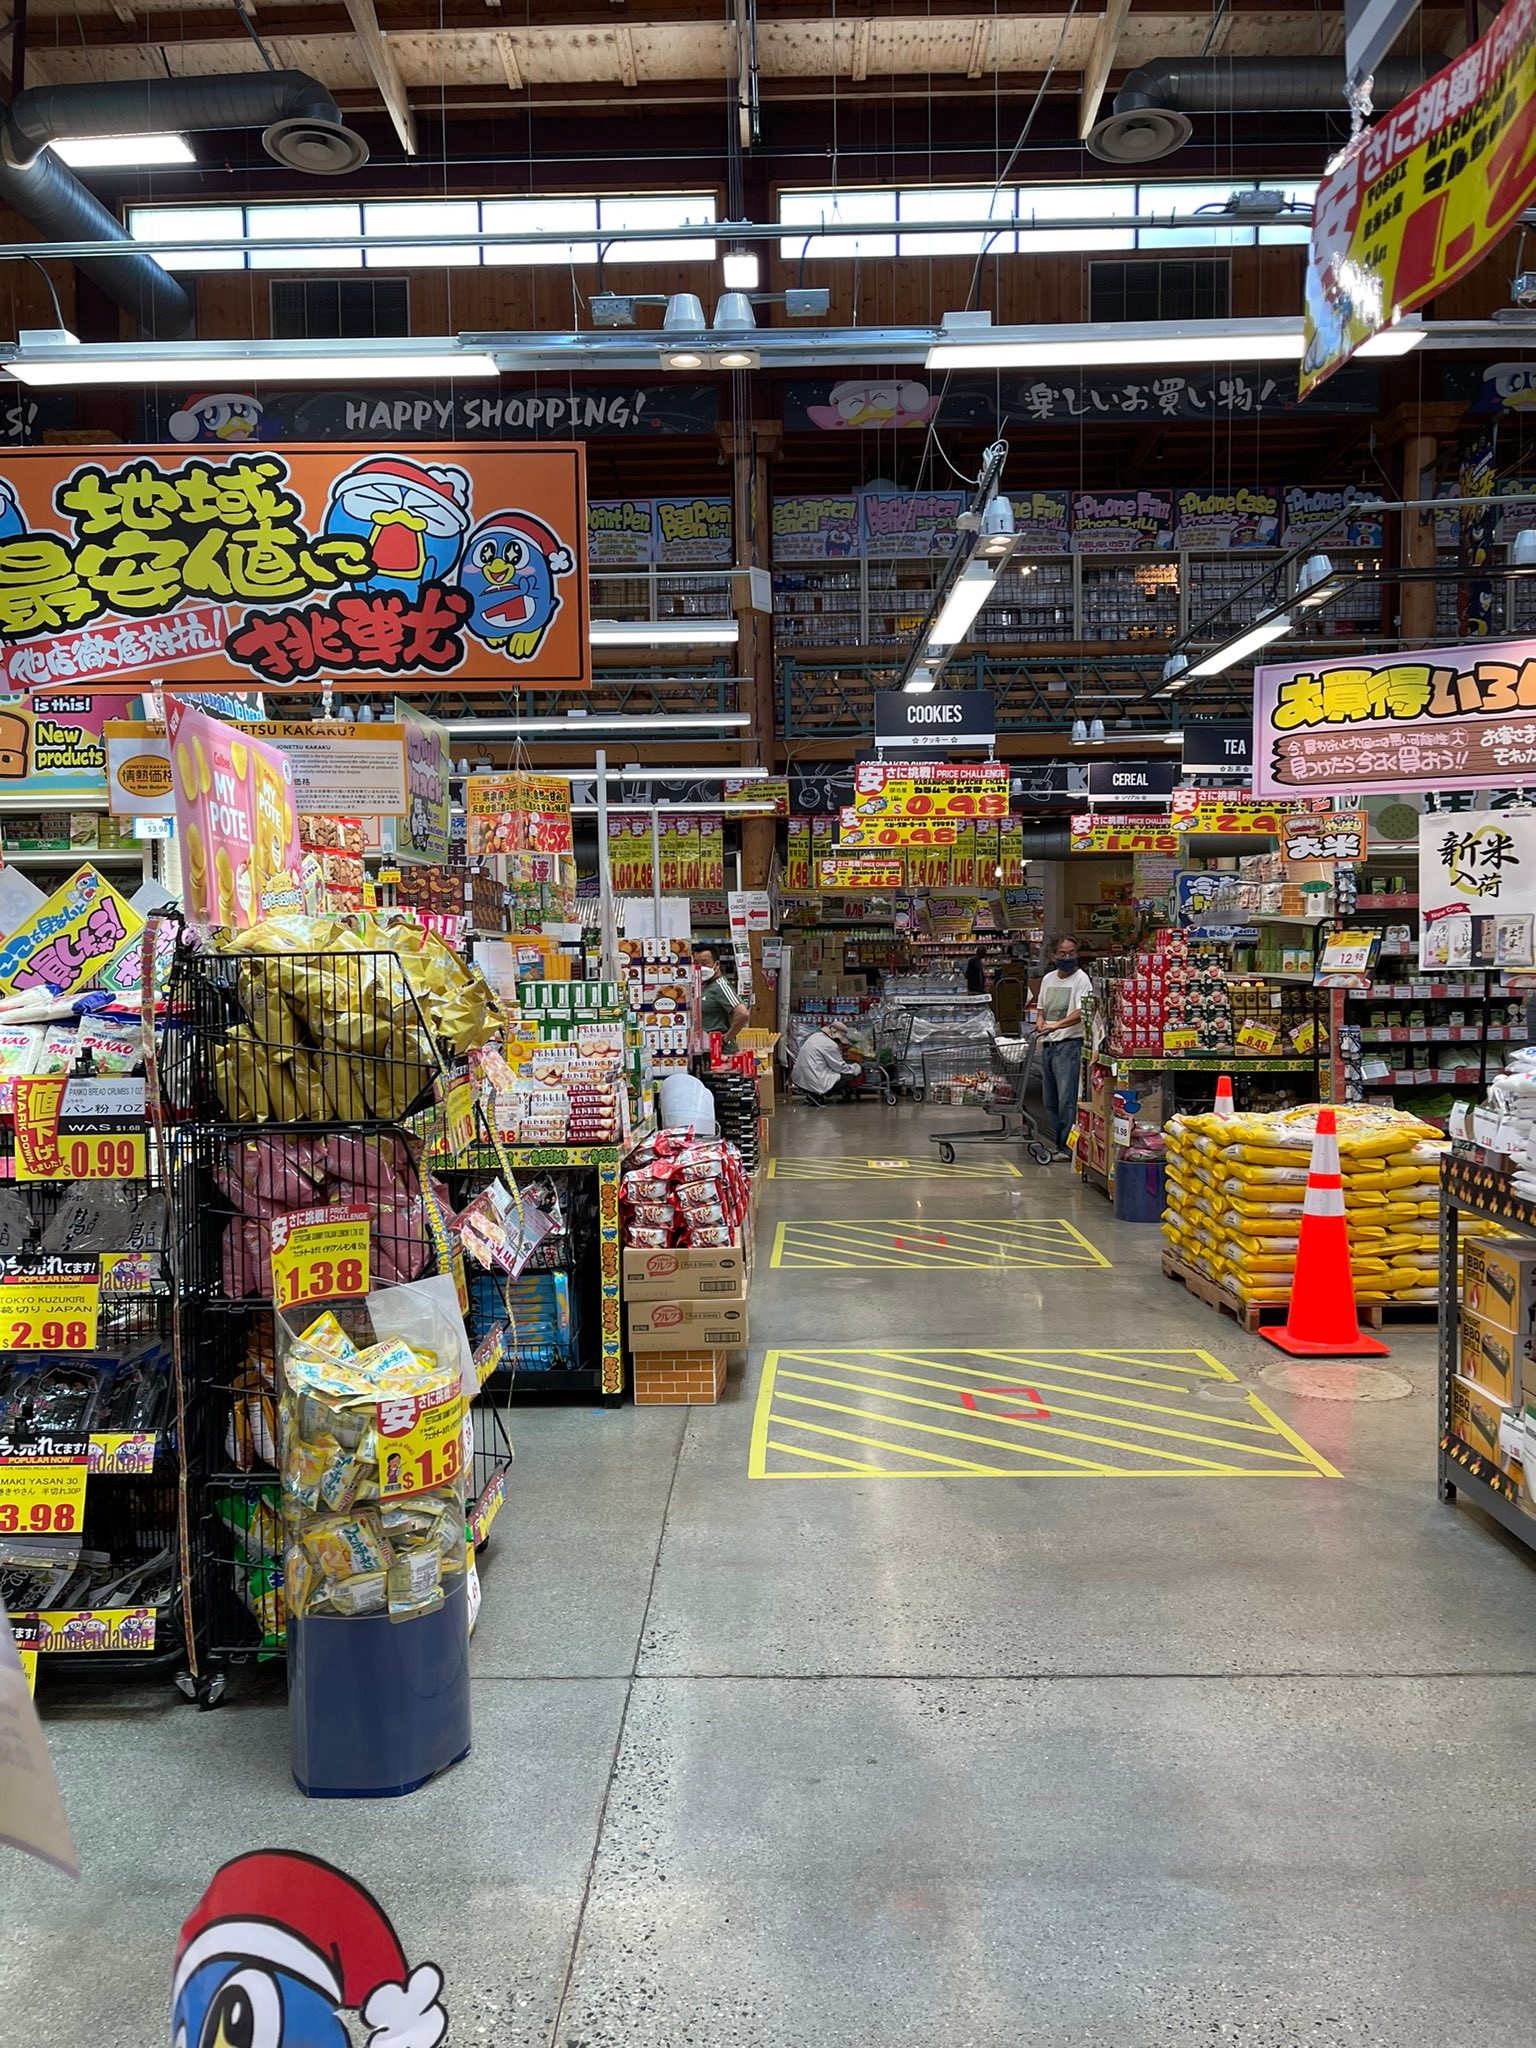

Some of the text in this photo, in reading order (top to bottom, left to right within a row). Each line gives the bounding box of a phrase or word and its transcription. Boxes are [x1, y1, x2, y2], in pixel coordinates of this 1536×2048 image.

[1363, 37, 1491, 183] さに挑戦!
[1024, 376, 1277, 420] 楽しいお買い物!
[345, 390, 647, 430] HAPPY SHOPPING!
[64, 462, 294, 534] 地域
[1032, 495, 1065, 519] Film
[1074, 491, 1171, 520] iPhone Film
[1179, 488, 1278, 516] iPhone Case
[1287, 488, 1346, 515] iPhone
[622, 501, 651, 533] Pen
[659, 503, 692, 527] Ball
[773, 502, 856, 520] echanical
[865, 498, 960, 520] Mechanical
[665, 522, 708, 541] Pen
[773, 518, 819, 536] encil
[870, 515, 917, 536] Pencil
[0, 527, 370, 634] 最安値に
[243, 586, 467, 677] 挑戦
[8, 607, 225, 684] 他店徹底対抗!
[34, 697, 91, 712] is this!
[907, 705, 963, 724] COOKIES
[37, 723, 80, 744] New
[283, 724, 356, 737] KAKAKU?
[921, 736, 950, 745] クッキー
[37, 746, 104, 768] products
[1224, 739, 1246, 755] TEA
[858, 768, 884, 793] 安
[886, 767, 1006, 779] さに挑戦! PRICE CHALLENGE
[1112, 773, 1149, 786] CEREAL
[213, 770, 236, 806] MY
[262, 778, 277, 804] MY
[1198, 791, 1242, 802] さに挑戦!
[905, 794, 1010, 815] 0.98
[1173, 791, 1198, 813] 安
[209, 800, 250, 842] POTE
[258, 796, 282, 830] POTE
[1093, 815, 1145, 825] さに挑戦! PRICE
[1216, 815, 1283, 832] 2.9
[147, 825, 169, 833] $3.98
[1072, 815, 1093, 835] 安
[878, 828, 956, 845] 0.98
[1106, 836, 1178, 850] 1.78
[1286, 833, 1360, 859] お米
[1437, 831, 1520, 870] 新米
[848, 875, 902, 886] 2.48
[1450, 868, 1503, 898] 入荷
[1430, 903, 1464, 919] New Crop
[81, 1037, 135, 1055] PANKO
[68, 1087, 88, 1097] PANKO
[88, 1087, 106, 1097] BREAD
[107, 1087, 130, 1097] CRUMBS
[17, 1084, 35, 1163] MARK DOWN
[28, 1081, 63, 1161] 値下げ
[68, 1124, 111, 1132] WAS
[71, 1140, 135, 1178] 0.99
[289, 1208, 329, 1227] さに挑戦!
[330, 1206, 349, 1214] PRICE
[330, 1212, 368, 1222] CHALLENGE
[272, 1216, 288, 1252] 安
[1467, 1254, 1486, 1271] BBQ
[18, 1275, 84, 1283] POPULAR NOW!
[286, 1258, 363, 1300] 1.38
[1466, 1267, 1485, 1284] GRILL
[38, 1296, 86, 1304] KUZUKIRI
[46, 1305, 93, 1313] JAPAN
[11, 1321, 87, 1349] 2.98
[1463, 1322, 1481, 1340] BBQ
[1463, 1336, 1481, 1353] GRILL
[1453, 1391, 1471, 1409] BBQ
[381, 1397, 416, 1435] 安
[8, 1456, 74, 1464] POPULAR NOW!
[0, 1503, 76, 1532] 3.98
